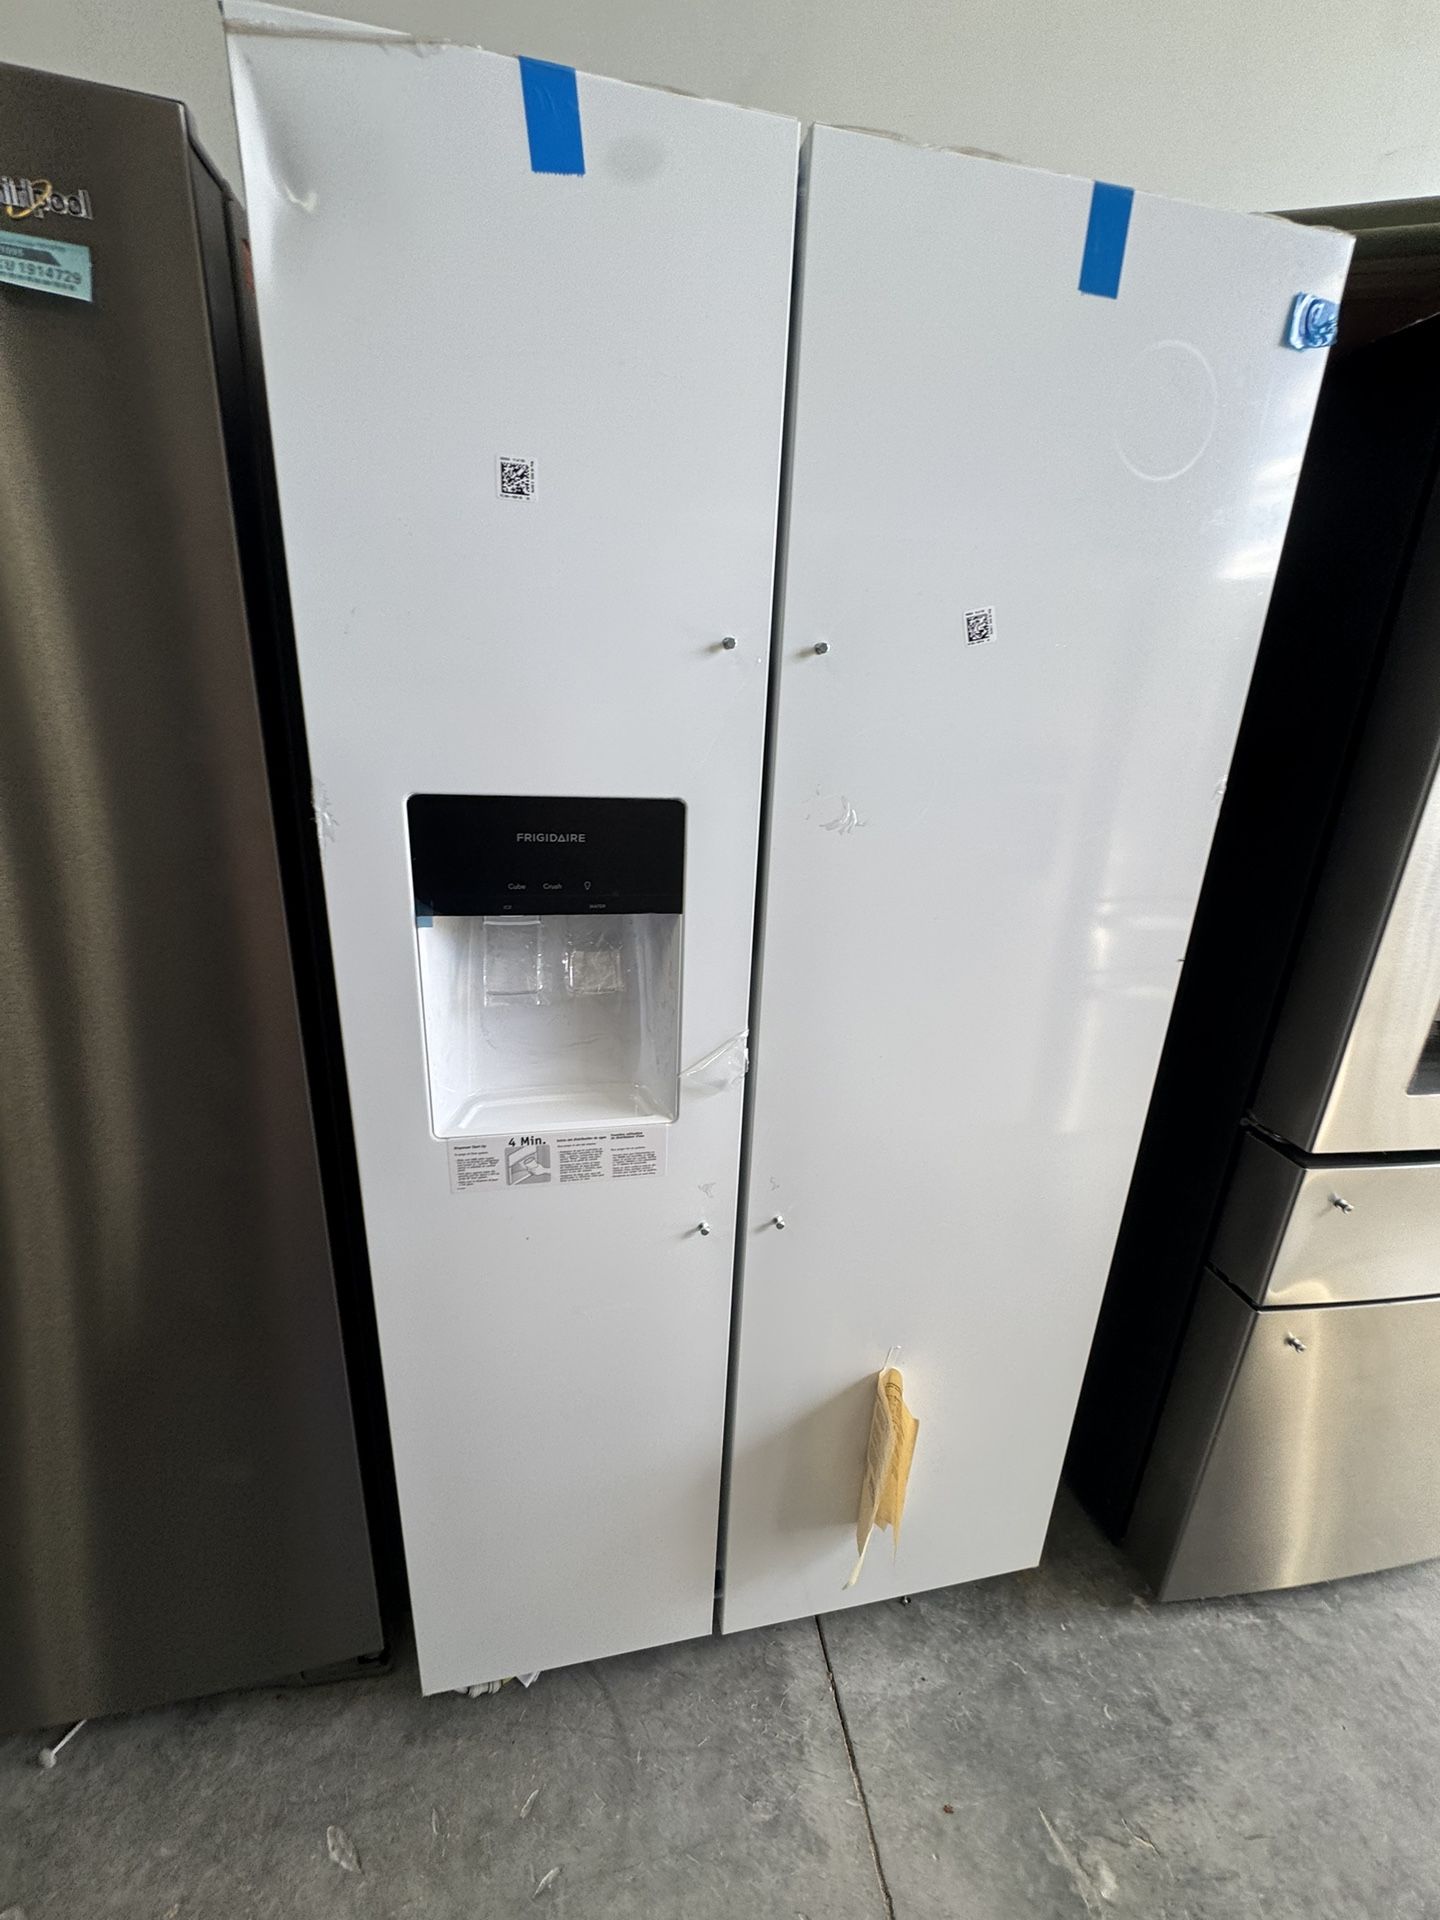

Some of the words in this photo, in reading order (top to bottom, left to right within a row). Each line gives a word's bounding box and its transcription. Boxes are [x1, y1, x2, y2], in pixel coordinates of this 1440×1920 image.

[516, 832, 587, 843] FRIGIDAIRE
[507, 882, 527, 890] Cube
[542, 882, 563, 890] Crush
[508, 1137, 516, 1147] 4
[520, 1136, 546, 1147] Min.
